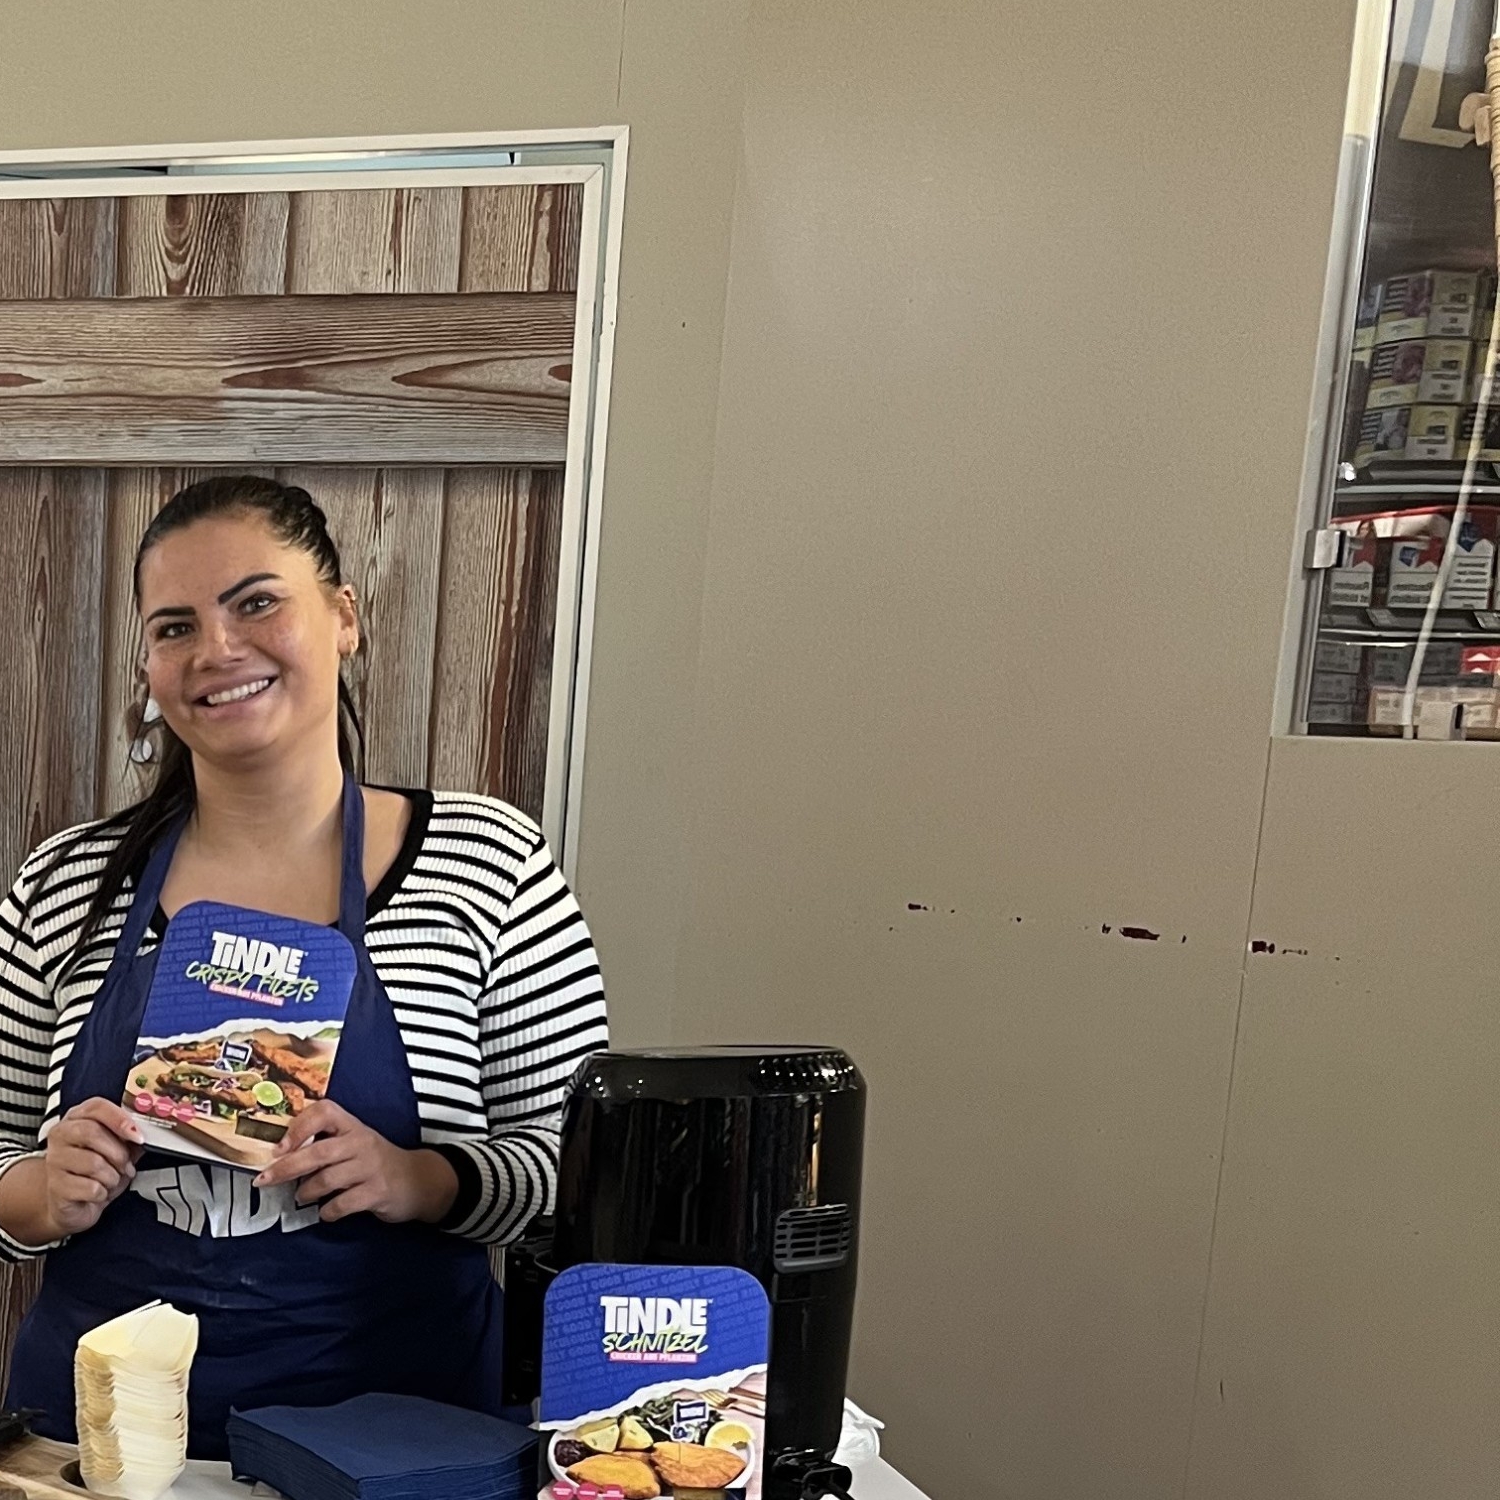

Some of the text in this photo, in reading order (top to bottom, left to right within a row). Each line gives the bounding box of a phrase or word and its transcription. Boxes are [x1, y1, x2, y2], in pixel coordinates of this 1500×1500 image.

[185, 961, 253, 992] CRISPY
[257, 975, 320, 1004] FILETS
[130, 1164, 320, 1238] TiNDL
[602, 1332, 709, 1354] SCHNITZEL
